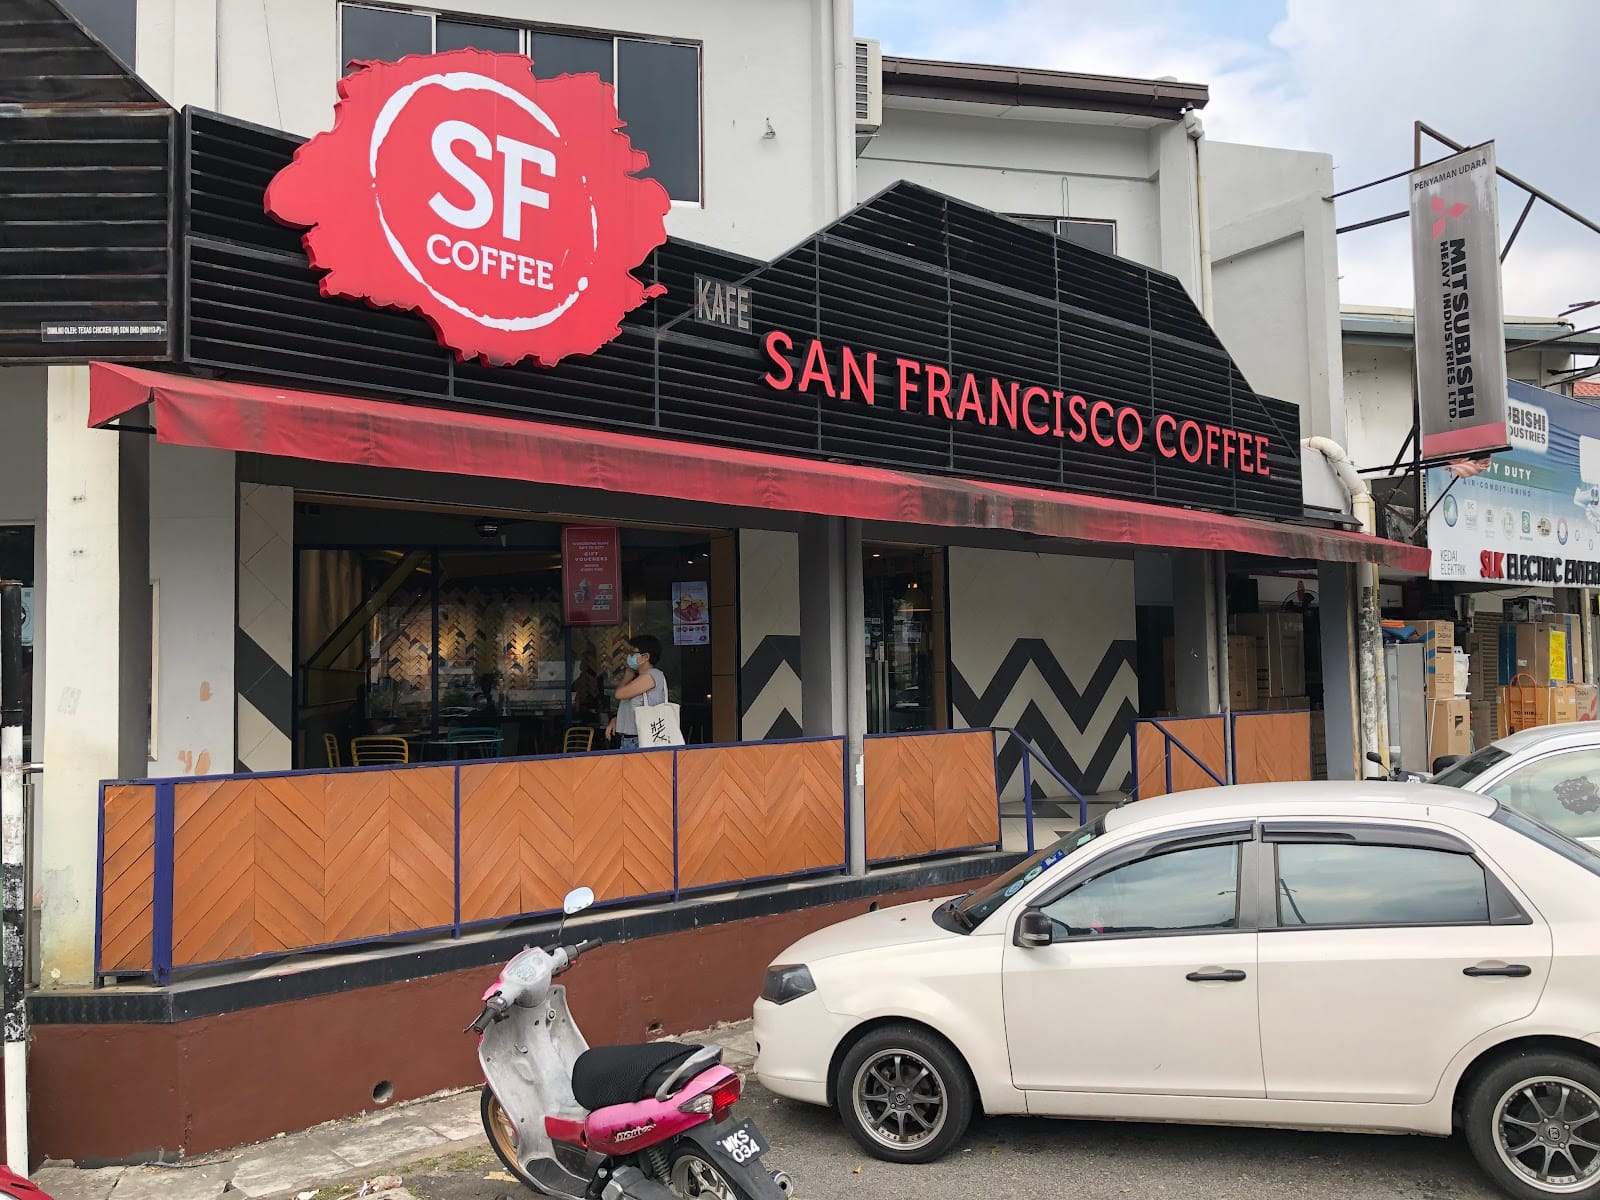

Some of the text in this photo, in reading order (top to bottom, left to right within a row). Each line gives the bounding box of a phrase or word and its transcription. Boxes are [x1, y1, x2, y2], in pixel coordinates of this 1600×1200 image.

[428, 120, 556, 241] SF
[1414, 158, 1487, 191] PENYAMAN UDARA
[427, 234, 553, 290] COFFEE
[698, 278, 750, 330] KAFE
[78, 326, 92, 334] TEXAS
[93, 326, 111, 334] CHICKEN
[120, 326, 129, 334] SDN
[130, 326, 139, 334] BHD
[1440, 240, 1451, 288] HEAVY
[1448, 391, 1457, 422] LTD.
[1450, 237, 1474, 418] MITSUBISHI
[762, 330, 1270, 475] SAN FRANCISCO COFFEE
[1504, 465, 1531, 480] DUTY
[1480, 550, 1504, 579] SLK
[1507, 553, 1562, 582] ELECTRIC
[722, 1129, 750, 1152] WKS
[732, 1138, 760, 1163] 034
